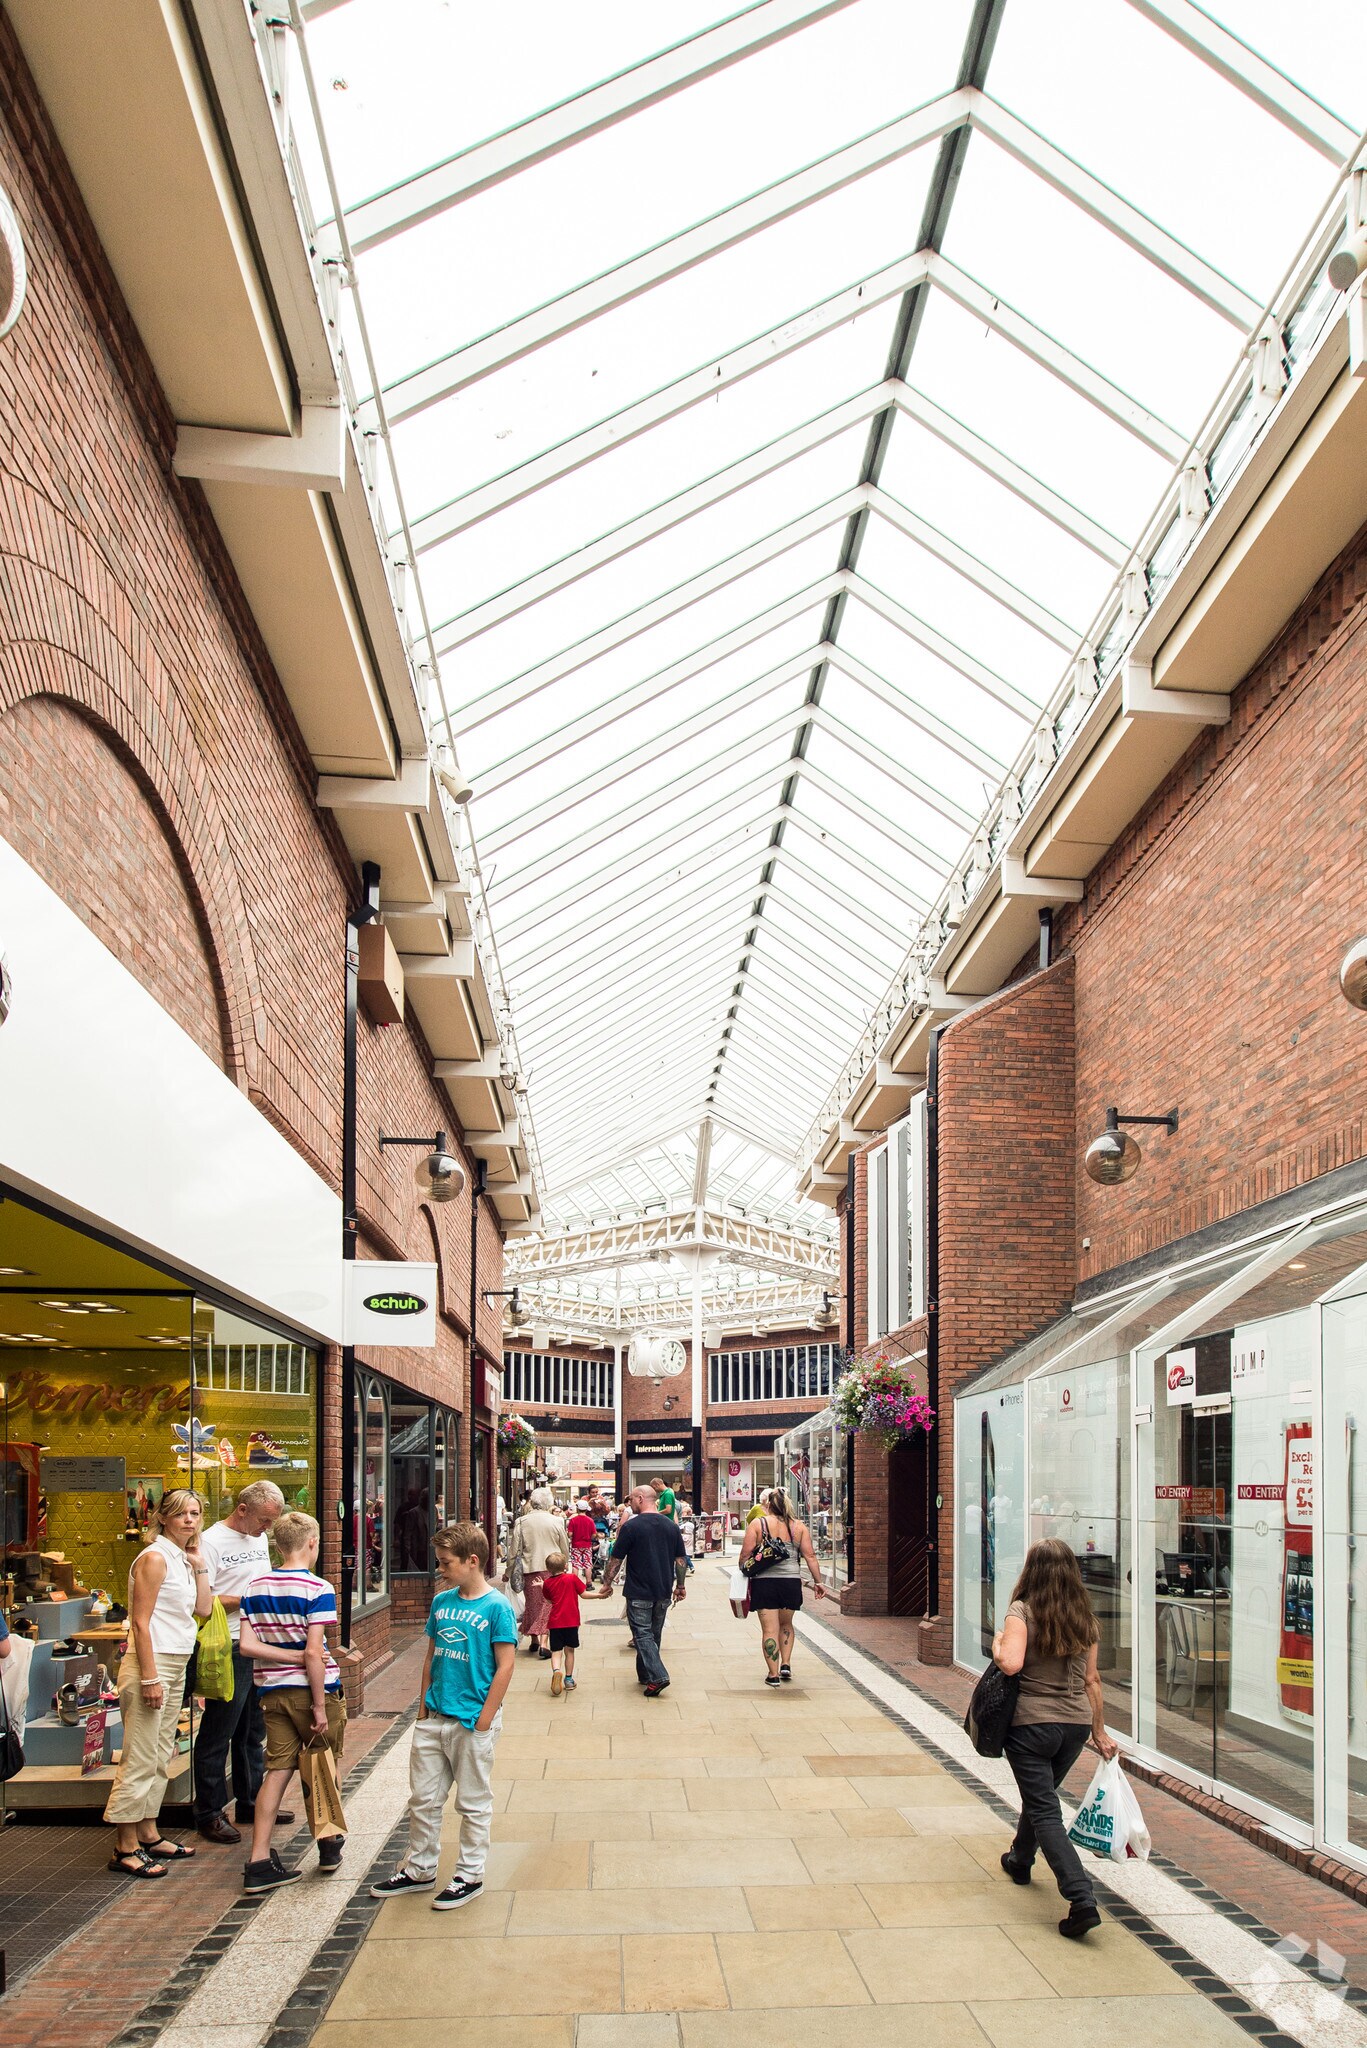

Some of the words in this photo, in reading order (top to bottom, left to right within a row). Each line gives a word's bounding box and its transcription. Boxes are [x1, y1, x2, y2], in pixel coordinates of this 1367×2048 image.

[370, 1297, 418, 1309] schuh
[1233, 1350, 1265, 1373] JUMP
[175, 1443, 215, 1453] addas
[1157, 1487, 1166, 1497] NO
[1169, 1487, 1191, 1498] ENTRY
[1240, 1487, 1252, 1498] NO
[1256, 1487, 1284, 1498] ENTRY
[445, 1648, 470, 1662] FINALS
[1290, 1670, 1309, 1678] worth
